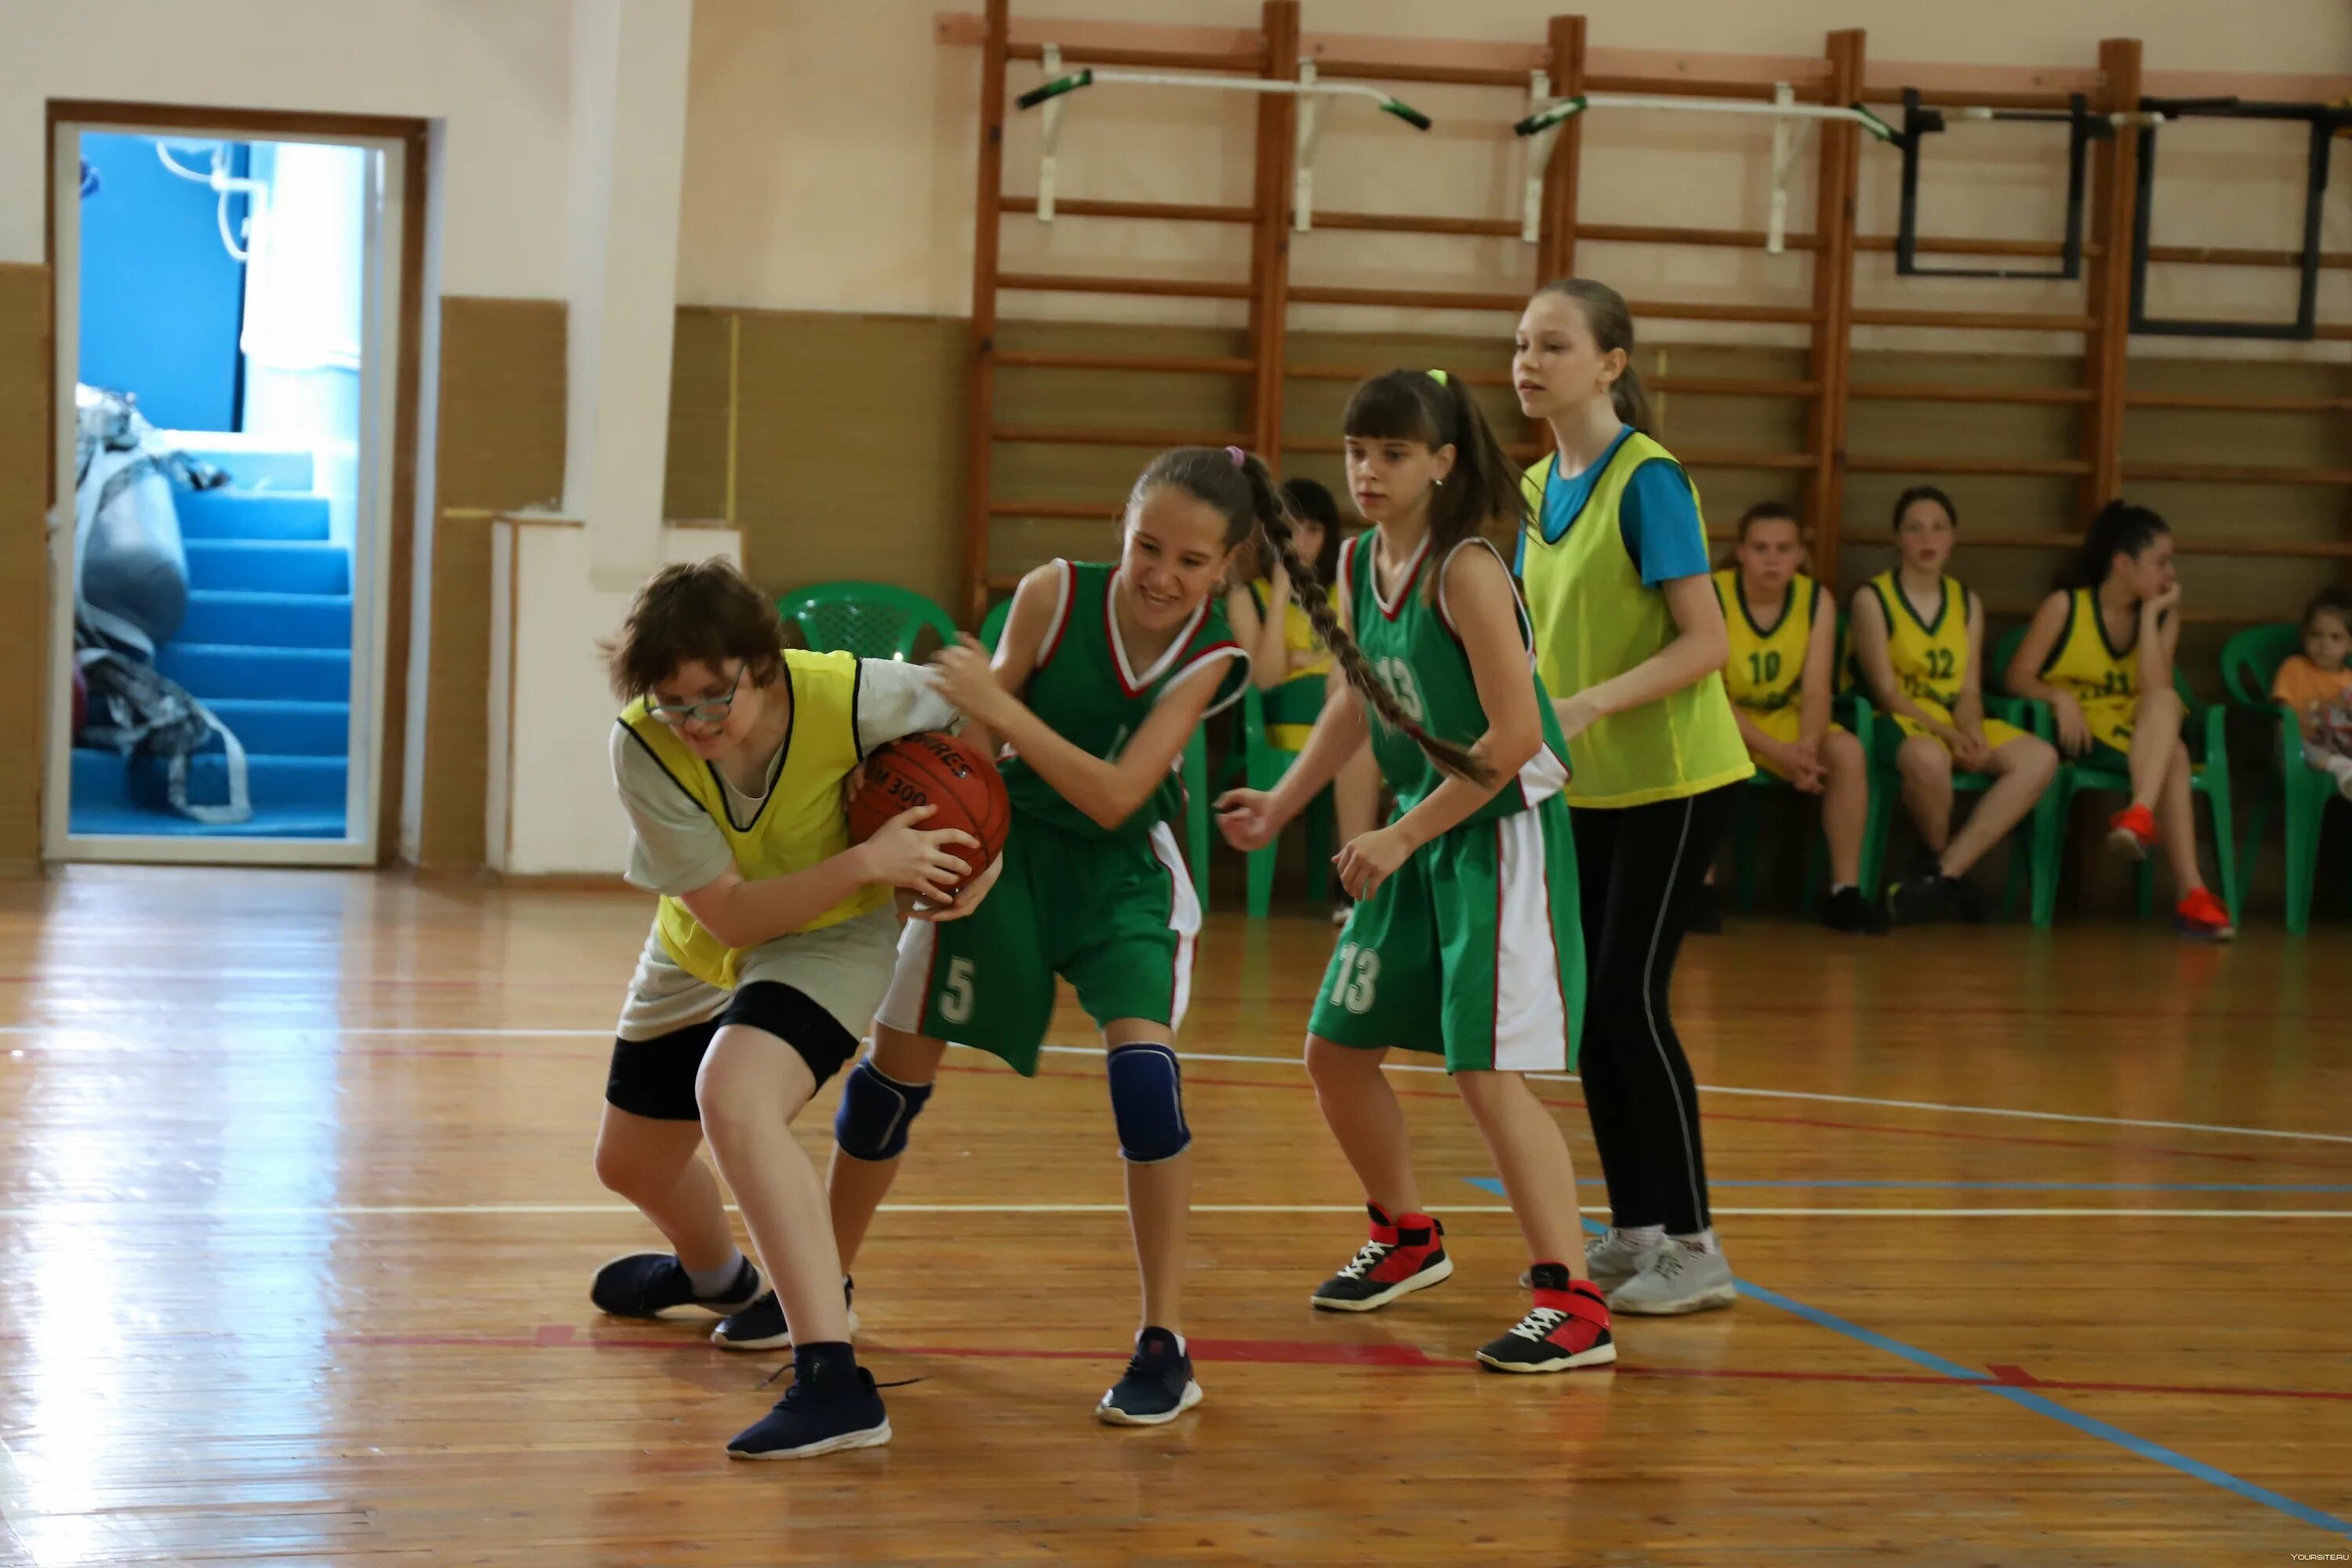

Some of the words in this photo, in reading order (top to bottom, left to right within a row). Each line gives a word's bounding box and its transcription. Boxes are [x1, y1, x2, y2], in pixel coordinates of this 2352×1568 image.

[1374, 655, 1424, 722] 13
[1748, 650, 1781, 686] 10
[1924, 647, 1955, 679] 12
[887, 777, 927, 807] 300
[938, 955, 975, 1025] 5
[1330, 942, 1381, 1014] 13
